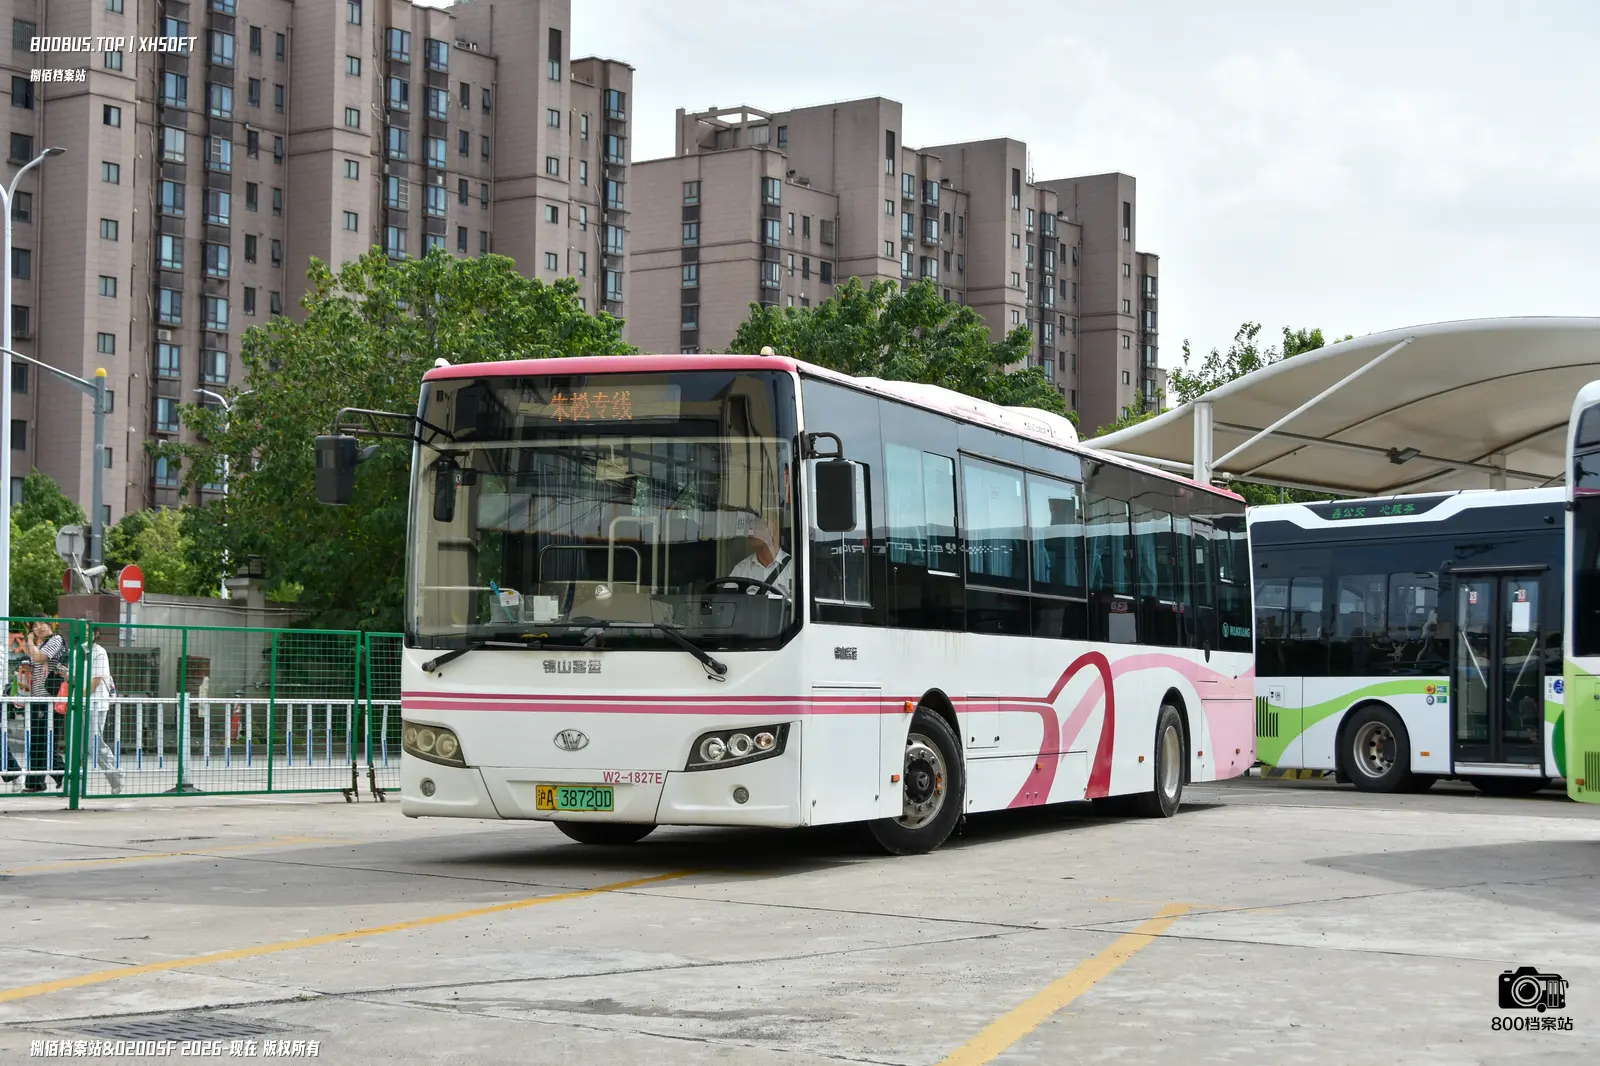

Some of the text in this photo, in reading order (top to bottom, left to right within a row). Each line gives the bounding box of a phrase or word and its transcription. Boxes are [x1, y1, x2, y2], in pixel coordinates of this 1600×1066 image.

[551, 391, 632, 421] 朱松专线
[603, 771, 663, 784] W2-1827E
[561, 789, 612, 808] 38720D
